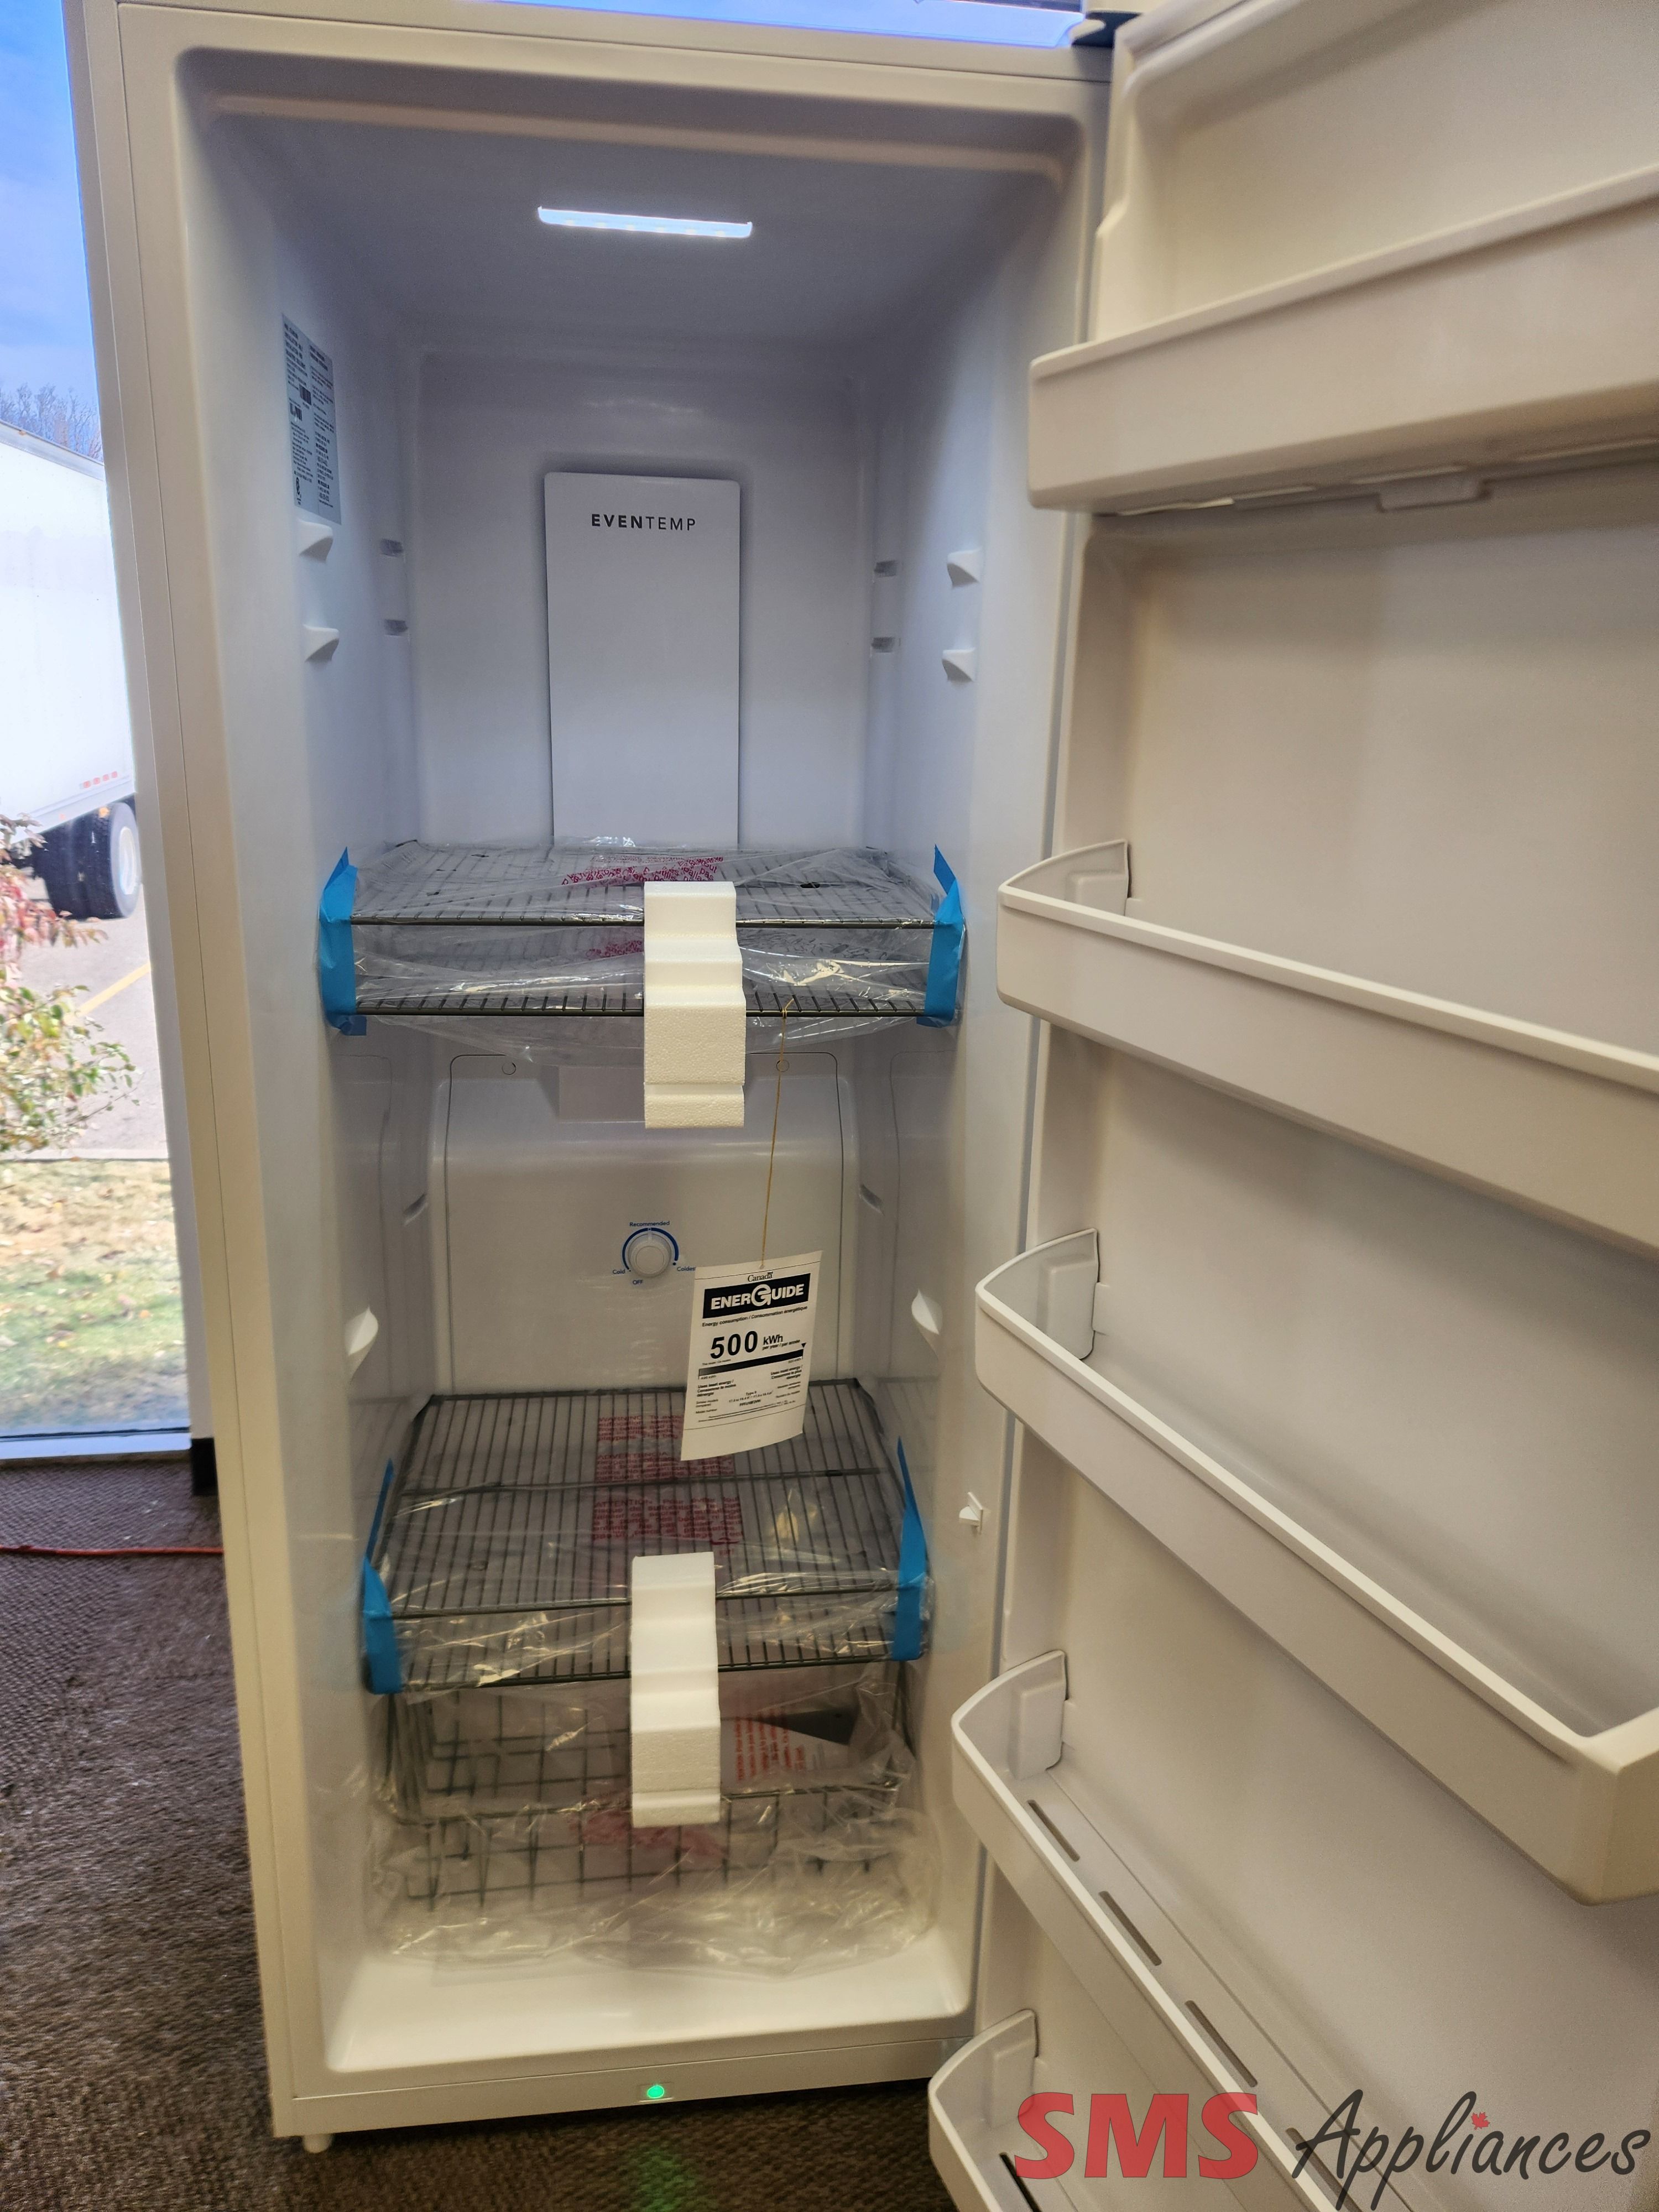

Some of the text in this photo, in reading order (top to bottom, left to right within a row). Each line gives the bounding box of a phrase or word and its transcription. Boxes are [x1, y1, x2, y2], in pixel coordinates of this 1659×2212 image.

[591, 513, 696, 531] EVENTEMP
[747, 1272, 773, 1282] Canada
[711, 1284, 805, 1310] ENERGUIDE
[719, 1316, 748, 1325] consumption
[751, 1310, 783, 1319] Consommation
[709, 1331, 783, 1359] 500 kWh
